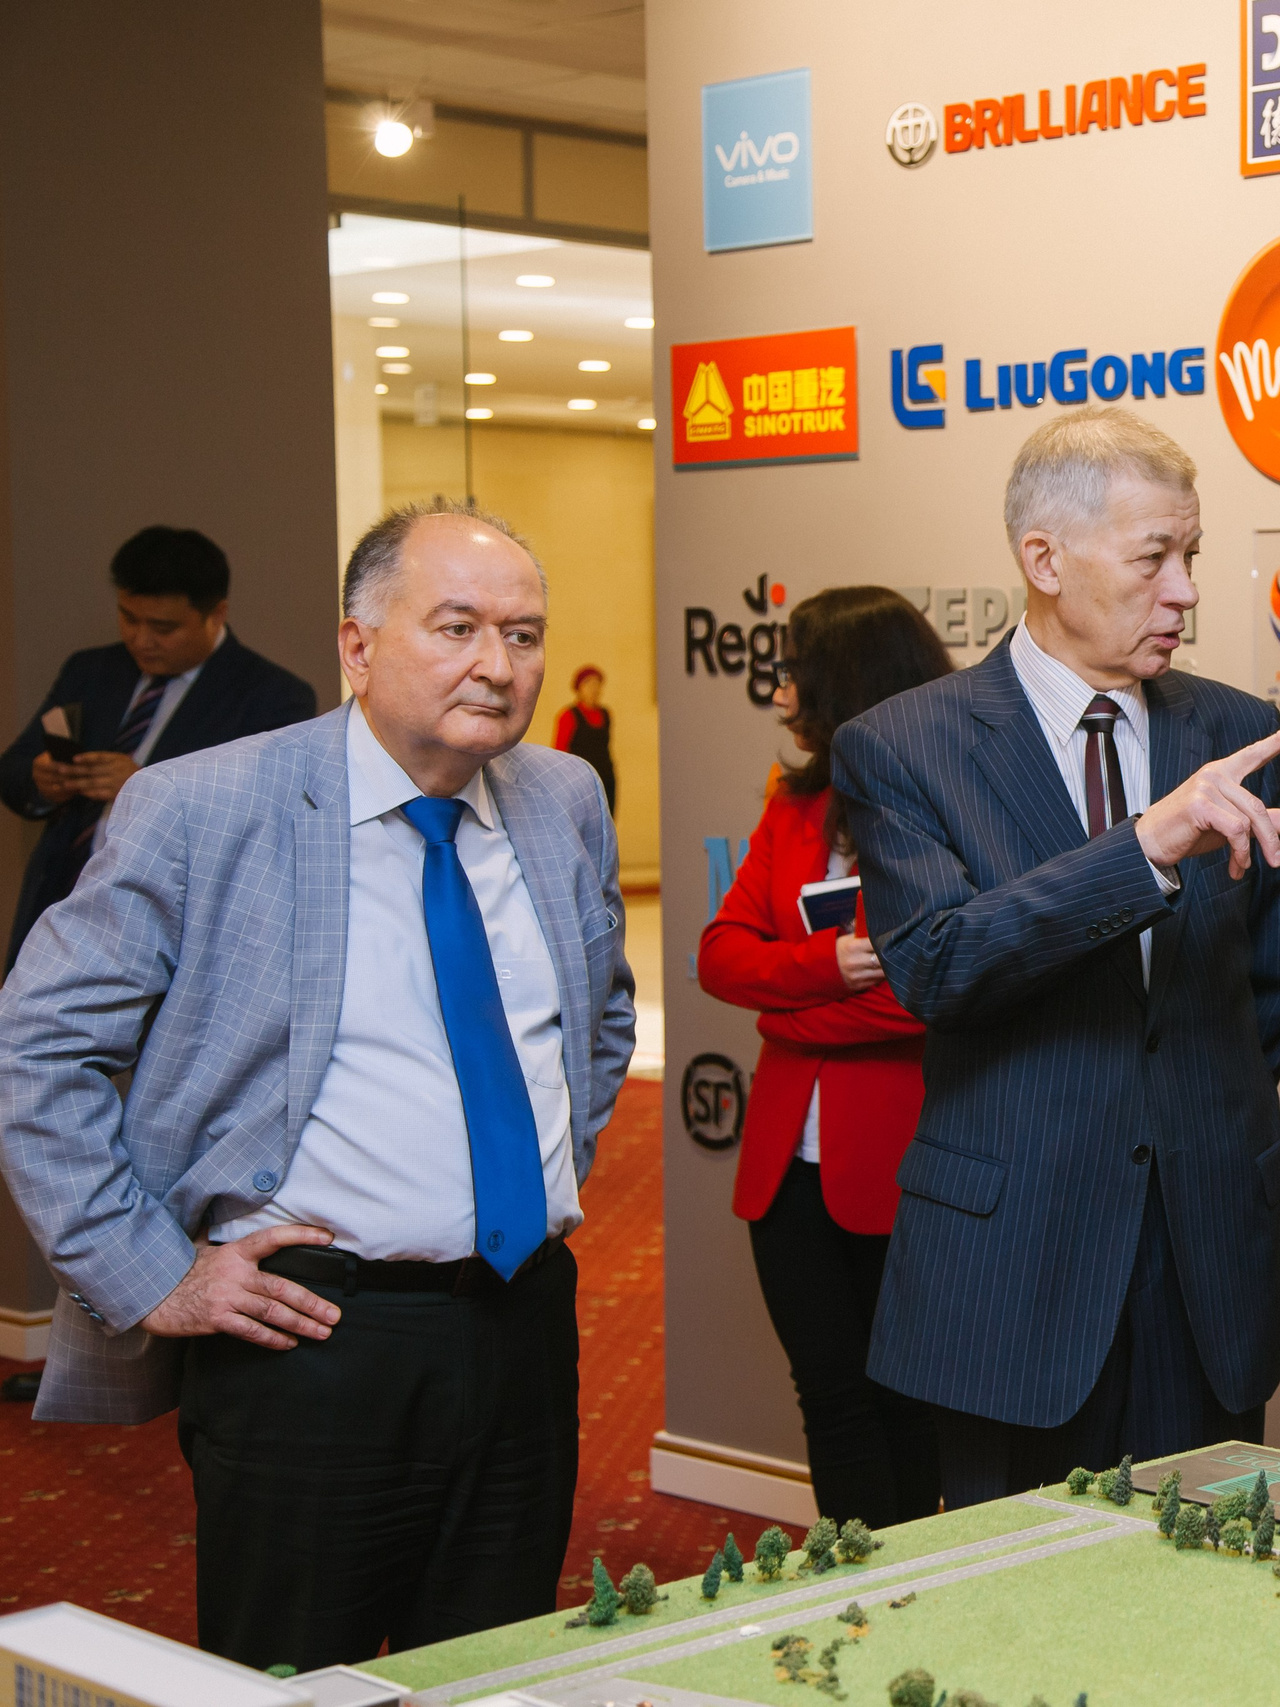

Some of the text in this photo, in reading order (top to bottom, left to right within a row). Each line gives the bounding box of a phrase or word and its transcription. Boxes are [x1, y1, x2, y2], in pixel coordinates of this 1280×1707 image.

[945, 63, 1207, 154] BRILLIANCE
[715, 130, 800, 172] vivo
[744, 408, 846, 438] SINOTRUK
